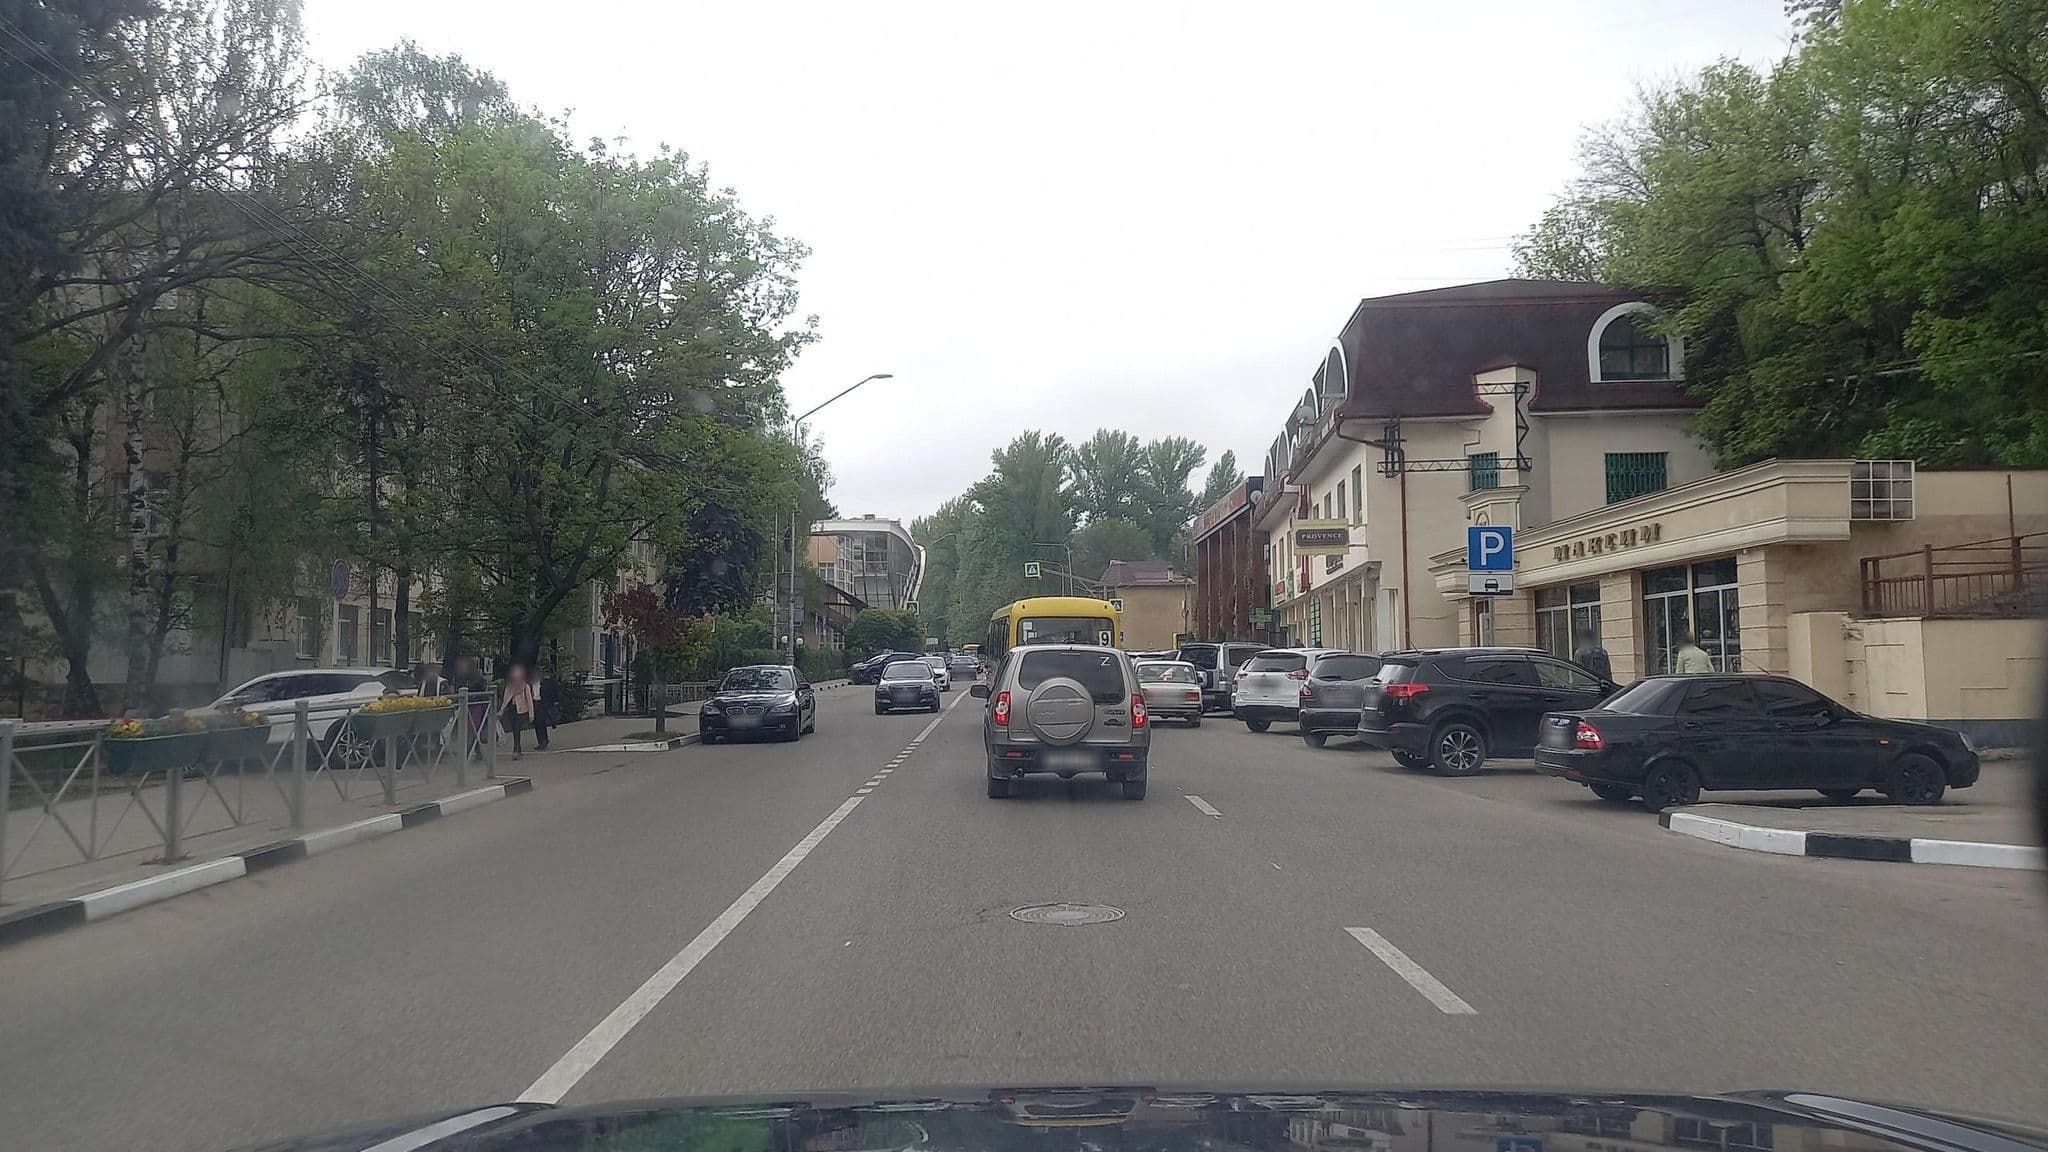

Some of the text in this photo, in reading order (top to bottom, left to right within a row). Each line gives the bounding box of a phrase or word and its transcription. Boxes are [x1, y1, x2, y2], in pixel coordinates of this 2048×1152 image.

[1301, 532, 1343, 540] PROVENCE
[1553, 522, 1662, 562] МАКСИМ
[1480, 531, 1505, 566] P
[1101, 631, 1110, 646] 9
[1100, 656, 1112, 666] Z
